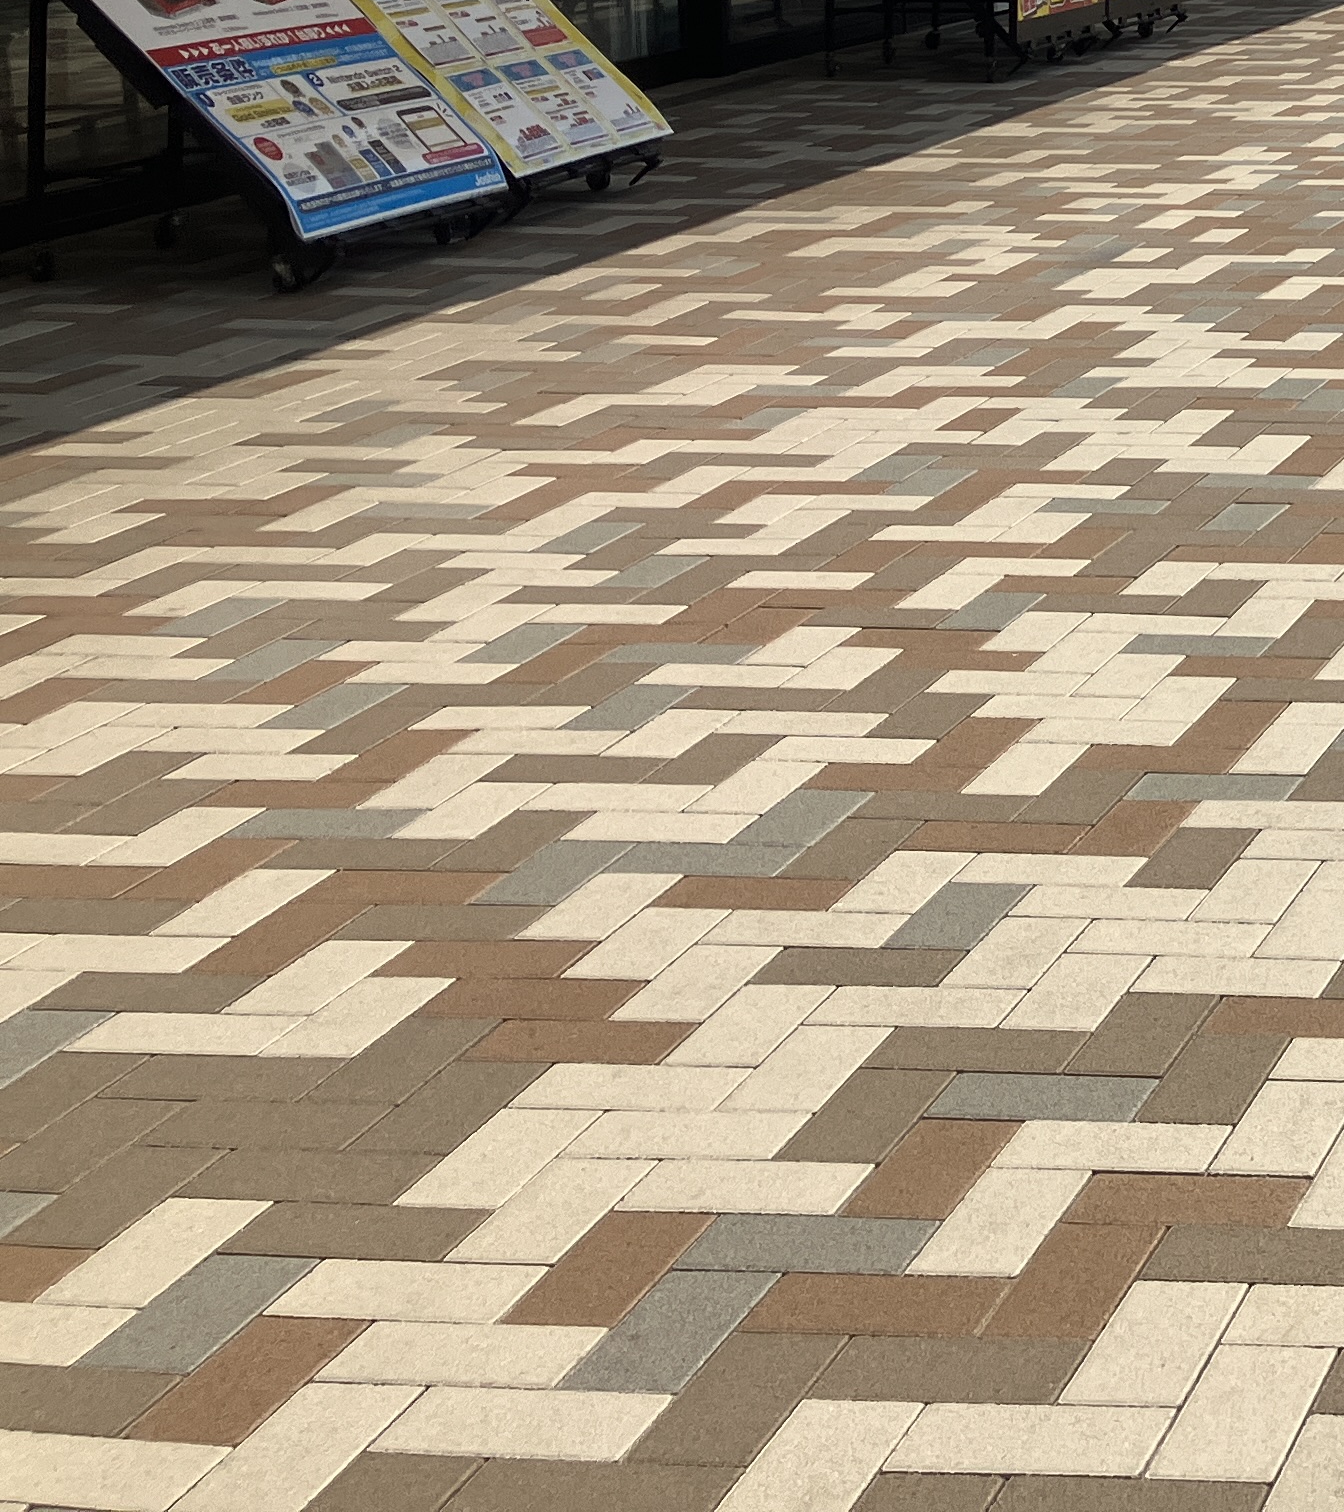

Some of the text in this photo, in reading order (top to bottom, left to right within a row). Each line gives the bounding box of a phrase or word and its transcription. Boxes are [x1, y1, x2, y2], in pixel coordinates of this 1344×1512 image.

[171, 57, 257, 90] 販売条件
[474, 172, 502, 187] Joshin
